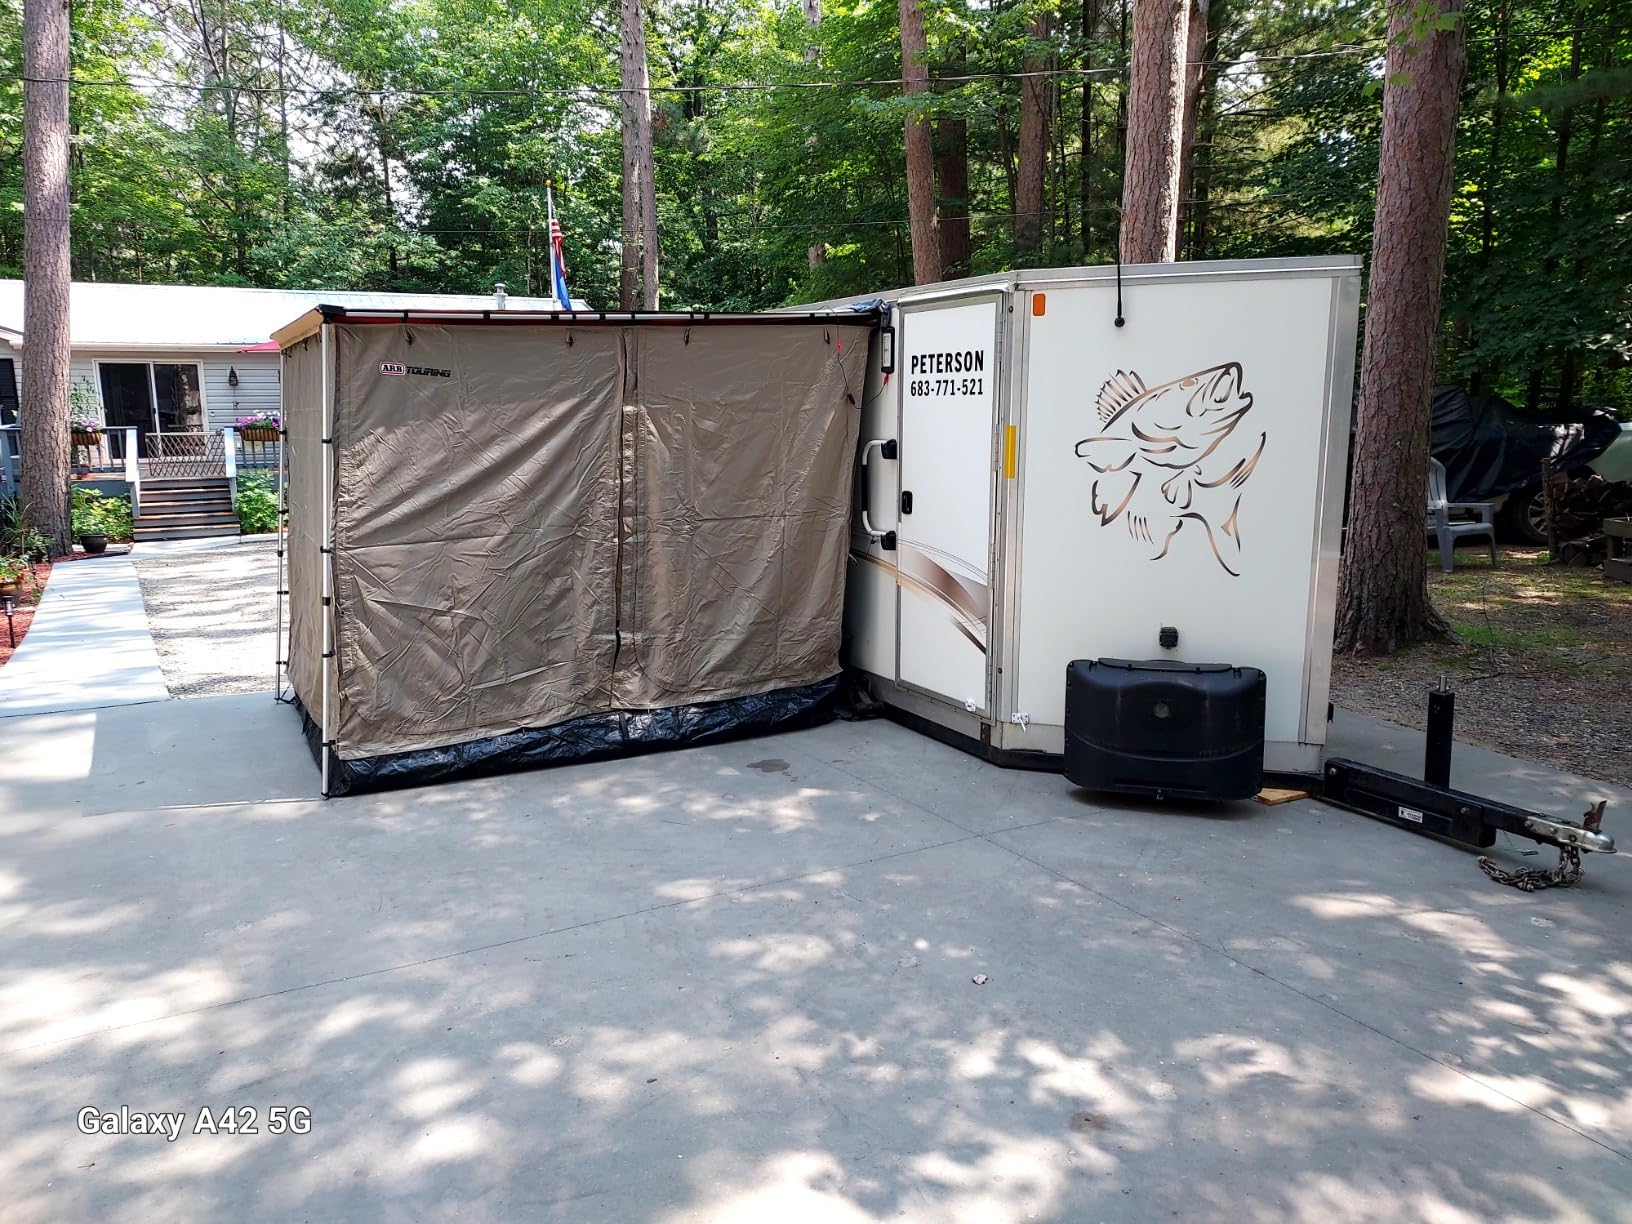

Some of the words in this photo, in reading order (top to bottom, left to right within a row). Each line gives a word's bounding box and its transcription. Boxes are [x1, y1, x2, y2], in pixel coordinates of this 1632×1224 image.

[381, 363, 403, 373] ARB
[406, 366, 452, 377] TOURING
[911, 350, 984, 374] PETERSON
[910, 378, 984, 396] 683-771-521
